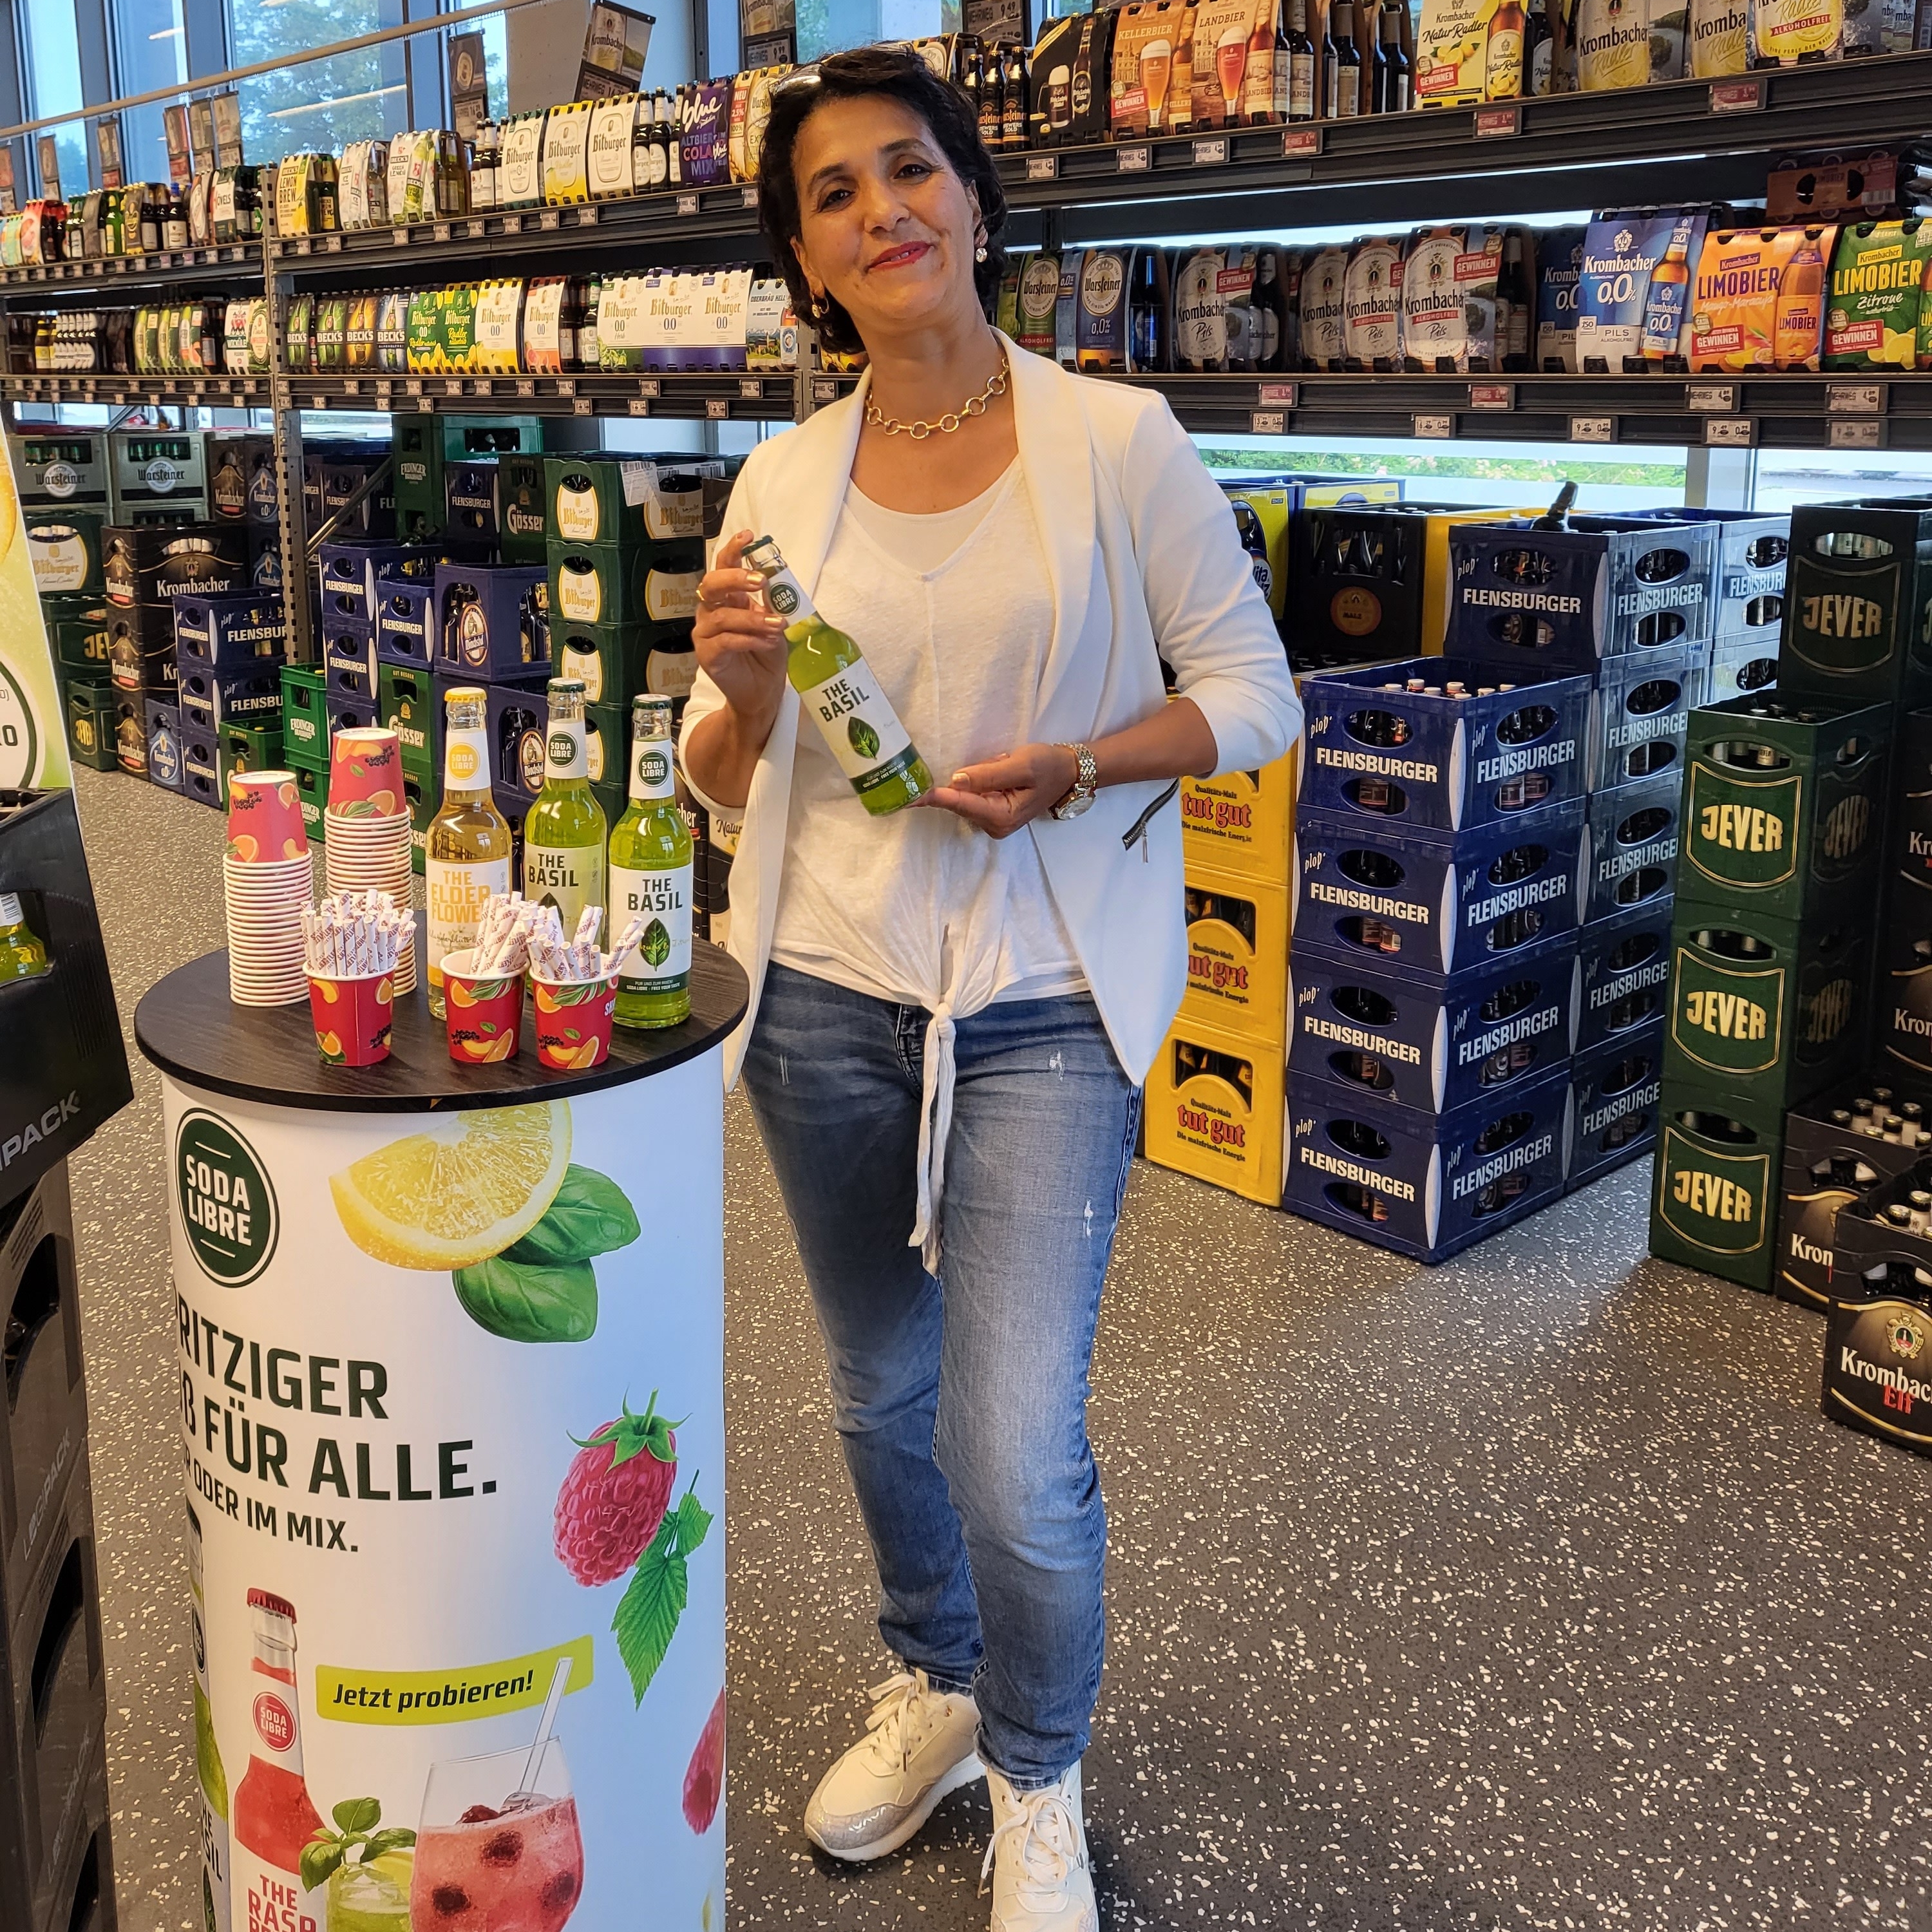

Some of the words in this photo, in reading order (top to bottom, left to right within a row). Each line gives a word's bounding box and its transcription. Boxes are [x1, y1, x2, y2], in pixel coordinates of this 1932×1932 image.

[1199, 11, 1245, 28] LANDBIER
[1436, 10, 1476, 24] Krombacher
[1774, 17, 1830, 35] ALKOHOLFREI
[1118, 24, 1173, 41] KELLERBIER
[1579, 22, 1648, 57] Krombacher
[734, 90, 746, 101] NEU
[682, 92, 723, 133] blue
[548, 140, 581, 158] Bitburger
[592, 135, 627, 153] Bitburger
[683, 144, 713, 161] COLA
[506, 147, 534, 165] Bitburger
[279, 177, 297, 190] LEMON
[279, 189, 296, 203] BREW
[1584, 253, 1657, 274] Krombacher
[1860, 248, 1900, 263] Krombacher
[1084, 276, 1122, 293] Warsteiner
[1698, 267, 1779, 300] LIMOBIER
[1834, 260, 1922, 296] LIMOBIER
[1023, 281, 1057, 296] Warsteiner
[604, 301, 638, 319] Bitburger
[650, 298, 692, 317] Bitburger
[705, 296, 741, 316] Bitburger
[1405, 289, 1464, 316] Krombacher
[1857, 293, 1904, 309] Zitrone
[412, 312, 437, 327] Bitburger
[445, 310, 470, 327] Bitburger
[481, 308, 511, 323] Bitburger
[530, 306, 554, 323] Bitburger
[1779, 317, 1816, 330] LIMOBIER
[287, 332, 307, 343] BECK'S
[317, 331, 343, 343] BECK'S
[346, 330, 374, 342] BECK'S
[377, 330, 405, 343] BECK'S
[1697, 333, 1739, 348] GEWINNEN
[1832, 330, 1877, 345] GEWINNEN
[35, 471, 86, 485] Warsteiner
[138, 468, 185, 482] Warsteiner
[452, 497, 491, 509] FLENSBURGER
[507, 504, 543, 535] Gösser
[563, 508, 592, 528] Bitburger
[157, 577, 231, 598] Krombacher
[325, 581, 363, 594] FLENSBURGER
[565, 588, 594, 609] Bitburger
[773, 589, 792, 605] SODA
[775, 596, 796, 611] LIBRE
[1463, 588, 1581, 614] FLENSBURGER
[1617, 583, 1703, 616] FLENSBURGER
[1803, 594, 1882, 638] JEVER
[179, 627, 209, 642] FLENSBURGER
[382, 619, 422, 635] FLENSBURGER
[330, 658, 367, 674] FLENSBURGER
[822, 678, 850, 699] THE
[183, 694, 213, 711] FLENSBURGER
[819, 687, 870, 722] BASIL
[549, 750, 572, 758] LIBRE
[550, 741, 572, 751] SODA
[451, 753, 473, 762] SODA
[451, 761, 474, 770] LIBRE
[641, 761, 664, 770] SODA
[1317, 747, 1437, 783] FLENSBURGER
[1477, 739, 1576, 784] FLENSBURGER
[186, 762, 216, 780] FLENSBURGER
[641, 768, 665, 777] LIBRE
[1182, 792, 1213, 820] tut
[1215, 802, 1252, 828] gut
[1701, 804, 1783, 853] JEVER
[538, 853, 565, 868] THE
[443, 871, 472, 886] THE
[529, 867, 579, 887] BASIL
[642, 878, 672, 892] THE
[431, 884, 491, 904] ELDER
[629, 893, 683, 911] BASIL
[1468, 874, 1567, 927] FLENSBURGER
[431, 902, 482, 923] FLOWE
[1311, 882, 1429, 925] FLENSBURGER
[1213, 961, 1249, 990] gut
[1686, 992, 1766, 1040] JEVER
[1305, 1016, 1421, 1065] FLENSBURGER
[1459, 1006, 1558, 1065] FLENSBURGER
[1177, 1104, 1209, 1135] tut
[1210, 1118, 1245, 1148] gut
[1301, 1147, 1415, 1202] FLENSBURGER
[1453, 1134, 1553, 1200] FLENSBURGER
[186, 1154, 251, 1211] SODA
[1674, 1170, 1752, 1222] JEVER
[187, 1188, 252, 1247] LIBRE
[1883, 1384, 1916, 1414] Elf
[204, 1395, 289, 1488] FÜR
[308, 1438, 497, 1501] ALLE.
[194, 1457, 239, 1521] ODER
[247, 1496, 278, 1538] IM
[287, 1511, 359, 1552] MIX.
[333, 1683, 392, 1709] Jetzt
[397, 1669, 534, 1713] probieren!
[260, 1705, 287, 1728] SODA
[260, 1718, 287, 1739] LIBRE
[260, 1874, 298, 1911] THE
[248, 1888, 316, 1932] RASP
